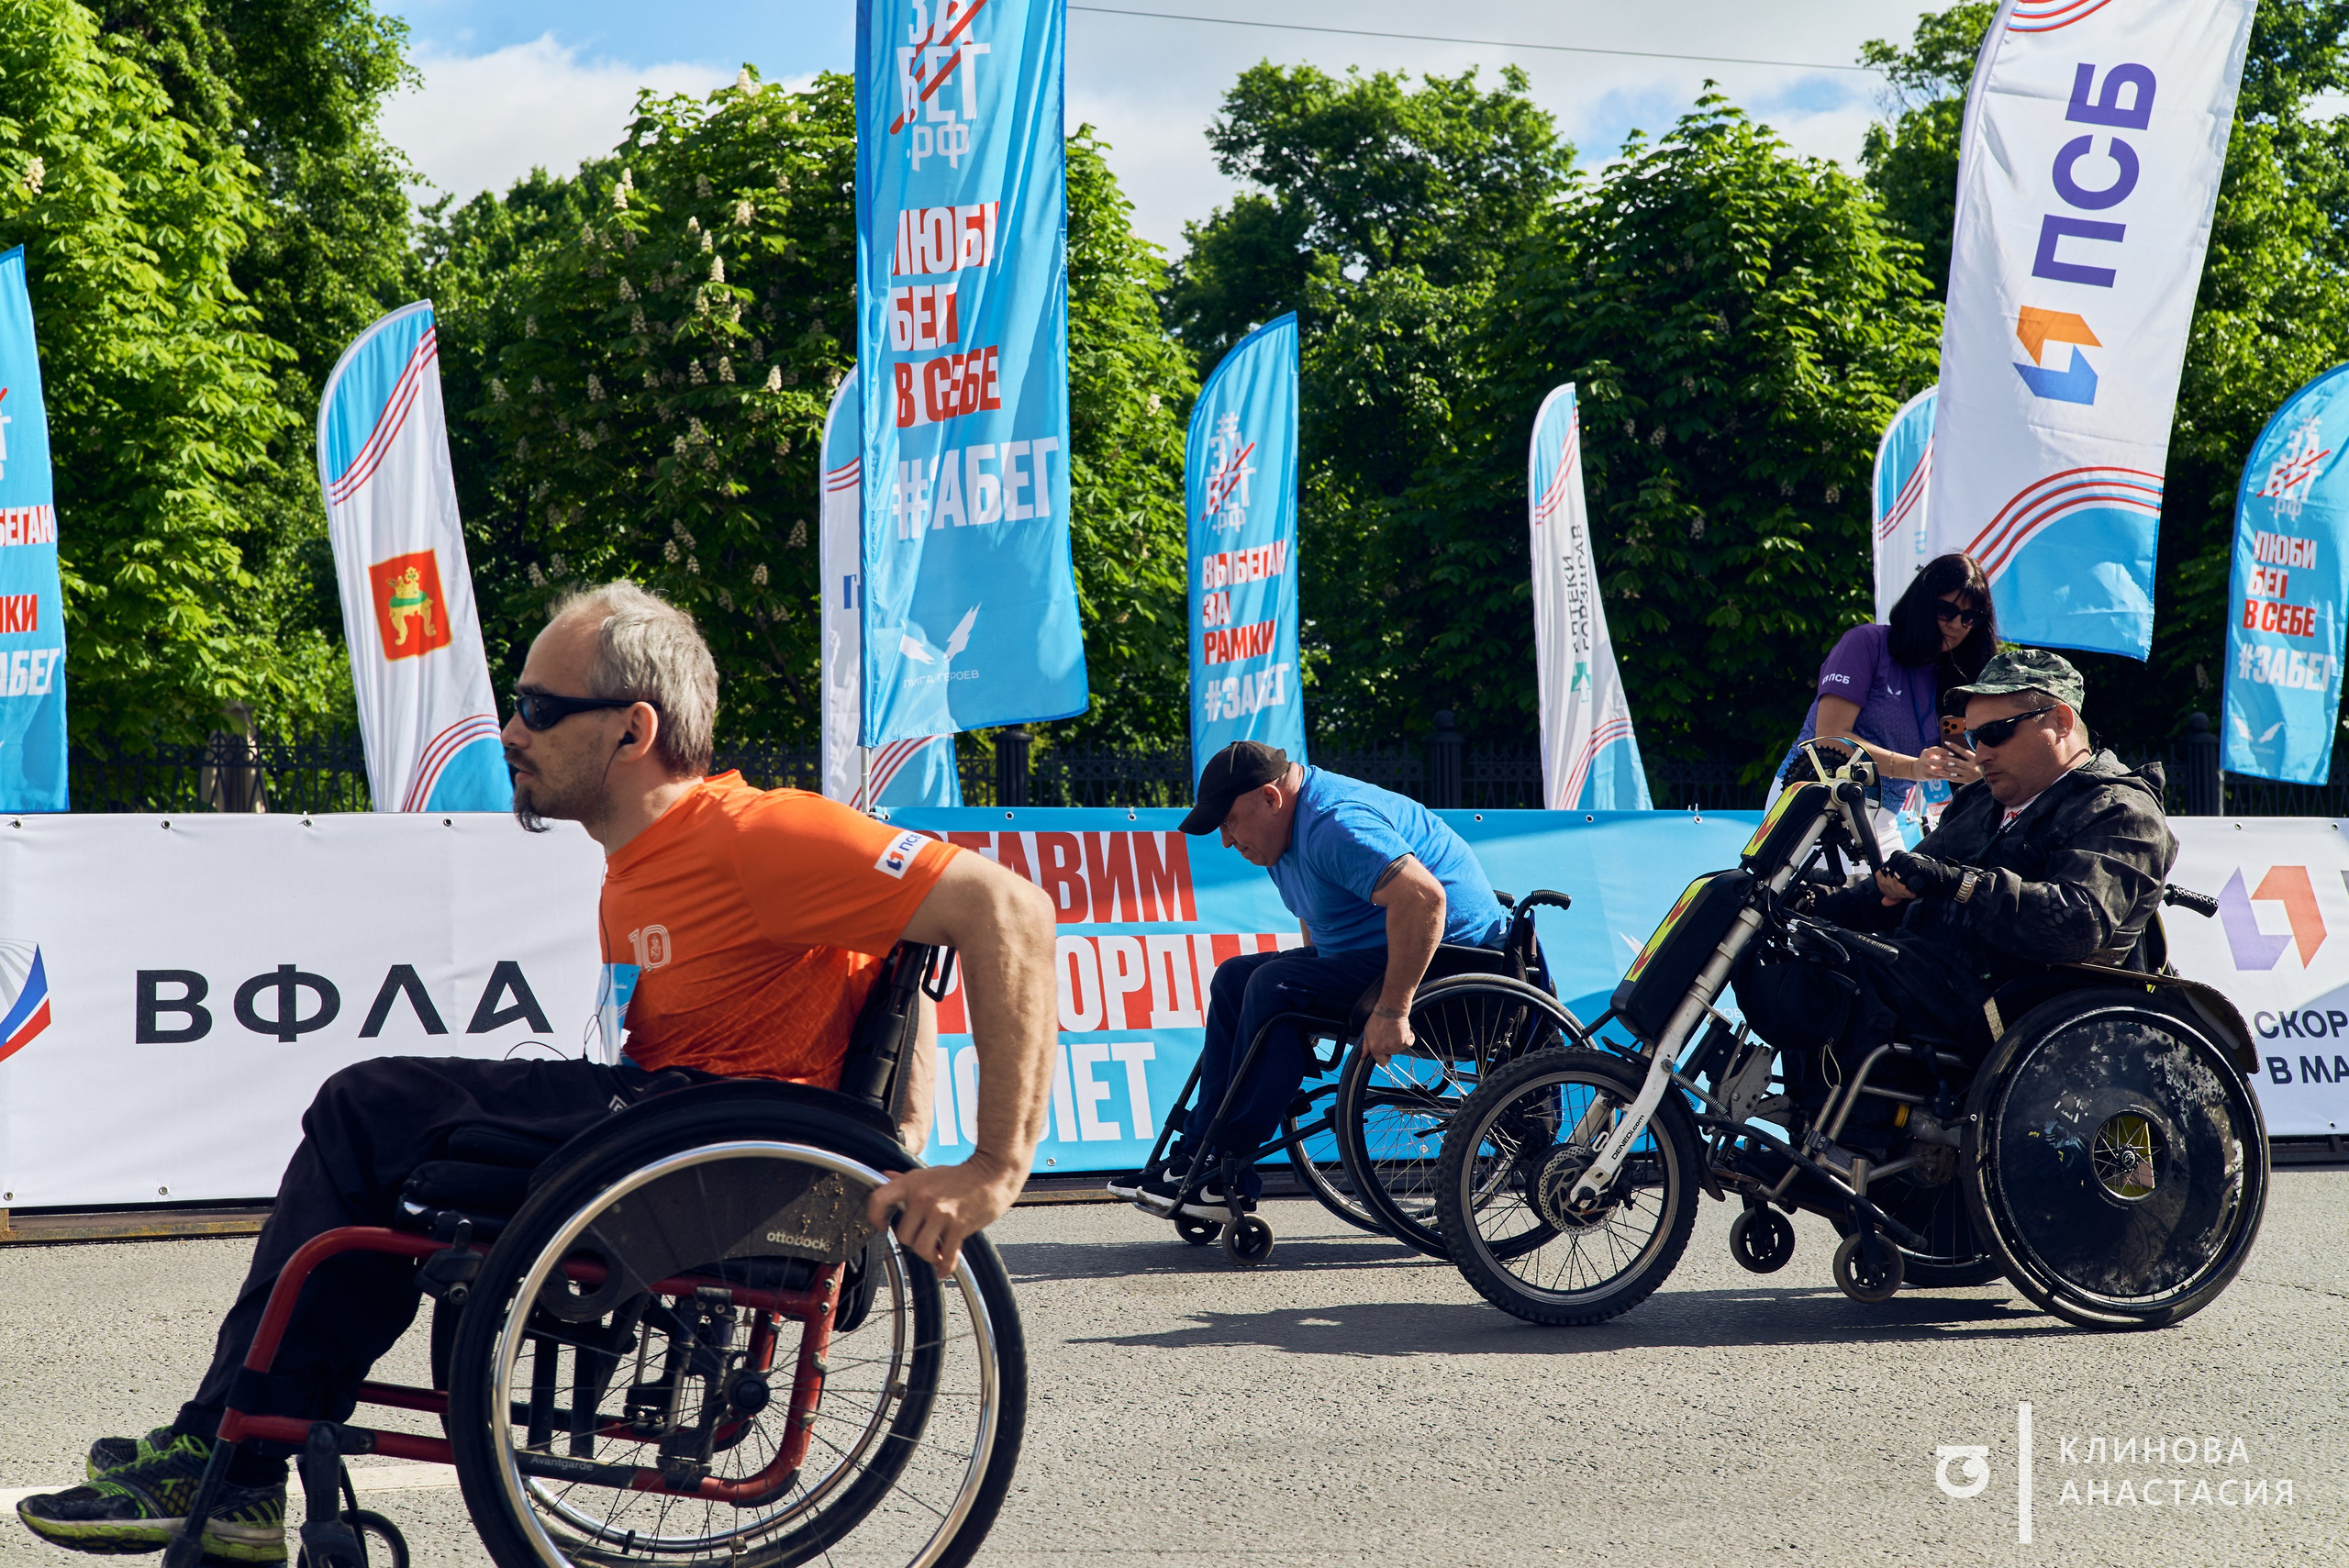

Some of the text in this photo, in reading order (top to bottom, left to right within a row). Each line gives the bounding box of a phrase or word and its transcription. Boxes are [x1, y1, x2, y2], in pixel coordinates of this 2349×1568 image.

[2031, 62, 2156, 288] ПСБ
[888, 282, 958, 351] БЕГ
[894, 345, 1001, 428] В СЕБЕ
[892, 436, 1059, 541] #АБЕГ
[2253, 530, 2318, 570] ЛЮБИ
[1562, 555, 1581, 653] ПТЕКИ
[2246, 564, 2289, 599] БЕГ
[1203, 591, 1230, 628] ЗА
[2243, 598, 2316, 638] В СЕБЕ
[1204, 619, 1275, 665] РАМКИ
[903, 669, 980, 689] ЛИГА ГЕРОЕВ
[2238, 642, 2338, 693] #ЗАБЕГ
[628, 924, 671, 969] 10
[135, 960, 555, 1045] ВФЛА
[2266, 1056, 2293, 1084] В
[766, 1231, 831, 1252] ottobock
[530, 1455, 594, 1472] Avantgarde
